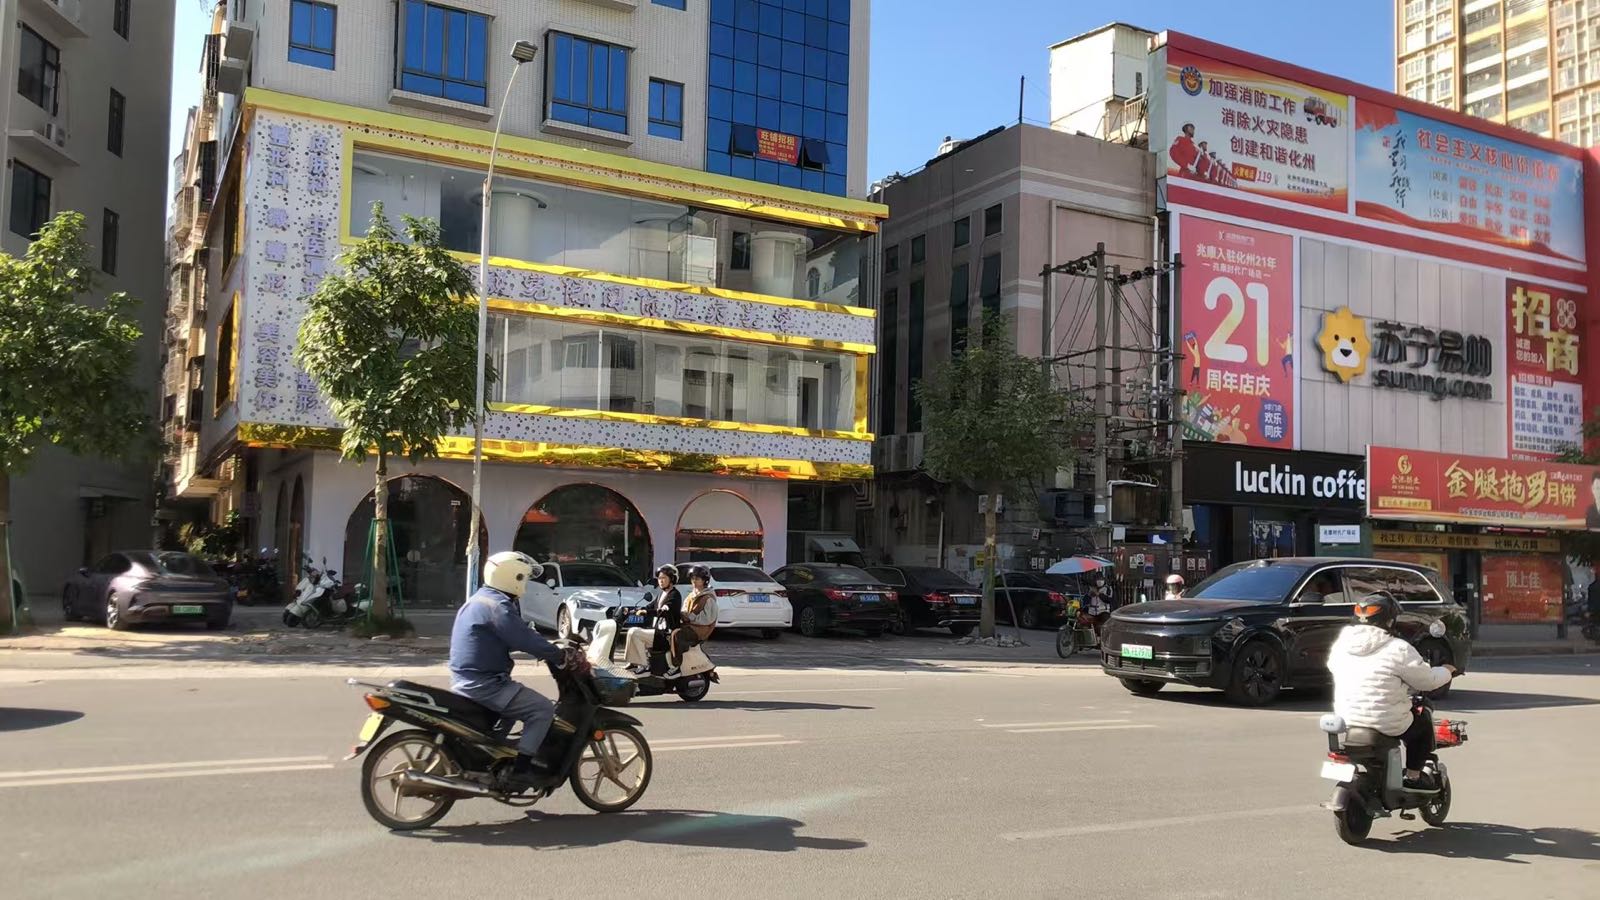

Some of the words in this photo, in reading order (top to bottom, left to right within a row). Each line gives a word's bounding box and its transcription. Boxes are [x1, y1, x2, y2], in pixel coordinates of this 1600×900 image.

[1208, 78, 1296, 115] 加强消防工作
[1221, 107, 1309, 145] 消除火灾隐患
[1230, 136, 1316, 171] 创建和谐化州
[1417, 128, 1559, 180] 社会主义核心价值观
[1257, 170, 1272, 184] 119
[1204, 276, 1269, 366] 21
[1373, 320, 1492, 377] 苏宁易购
[1206, 368, 1271, 397] 周年店庆
[1373, 369, 1492, 402] suning.com
[1264, 412, 1282, 425] 欢乐
[1264, 425, 1282, 438] 同庆
[1235, 461, 1306, 496] luckin
[1505, 571, 1541, 589] 顶上佳
